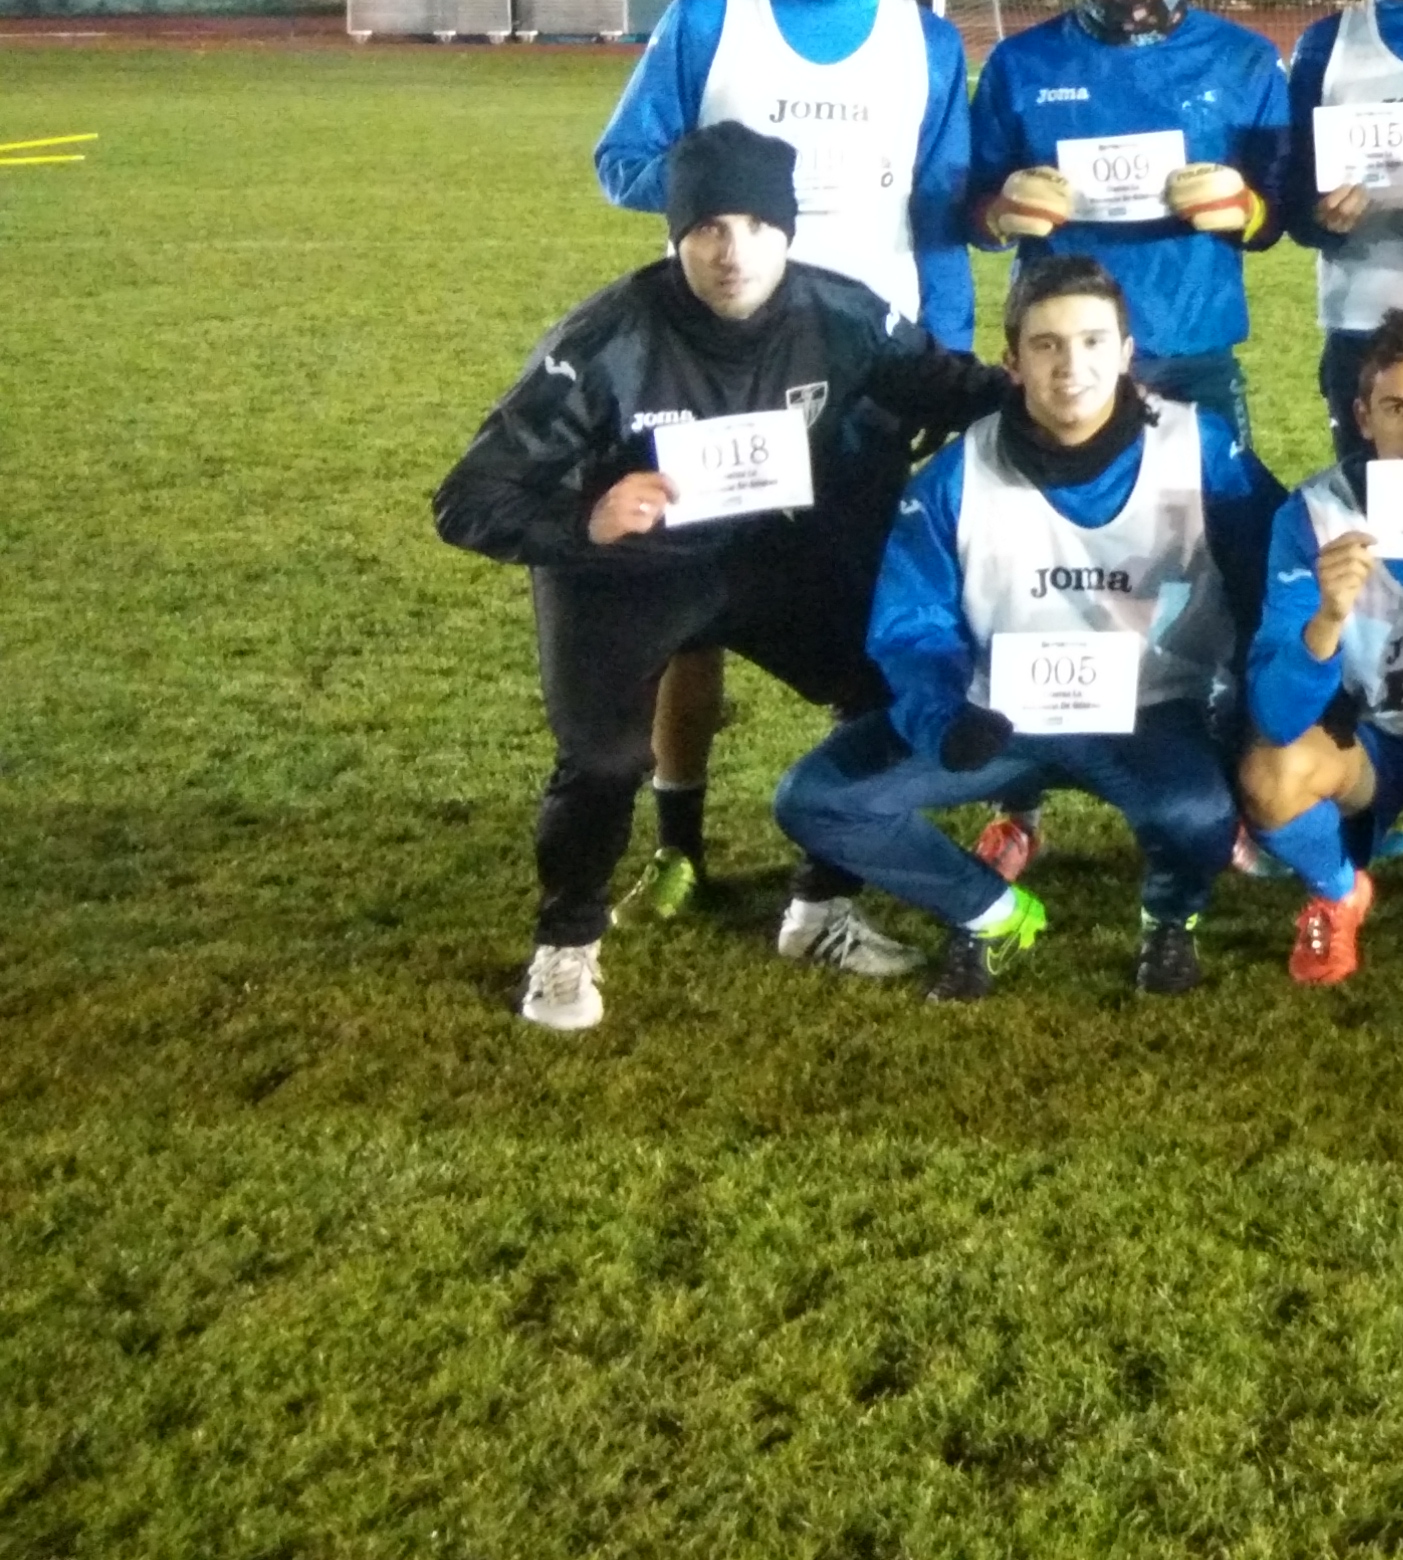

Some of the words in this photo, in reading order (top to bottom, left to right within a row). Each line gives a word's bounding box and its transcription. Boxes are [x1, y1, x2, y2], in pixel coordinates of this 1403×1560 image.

[769, 99, 869, 123] Joma
[1349, 122, 1403, 148] 015
[1093, 154, 1149, 182] 009
[702, 434, 769, 470] 018
[1030, 566, 1132, 598] Joma
[1031, 655, 1097, 686] 005
